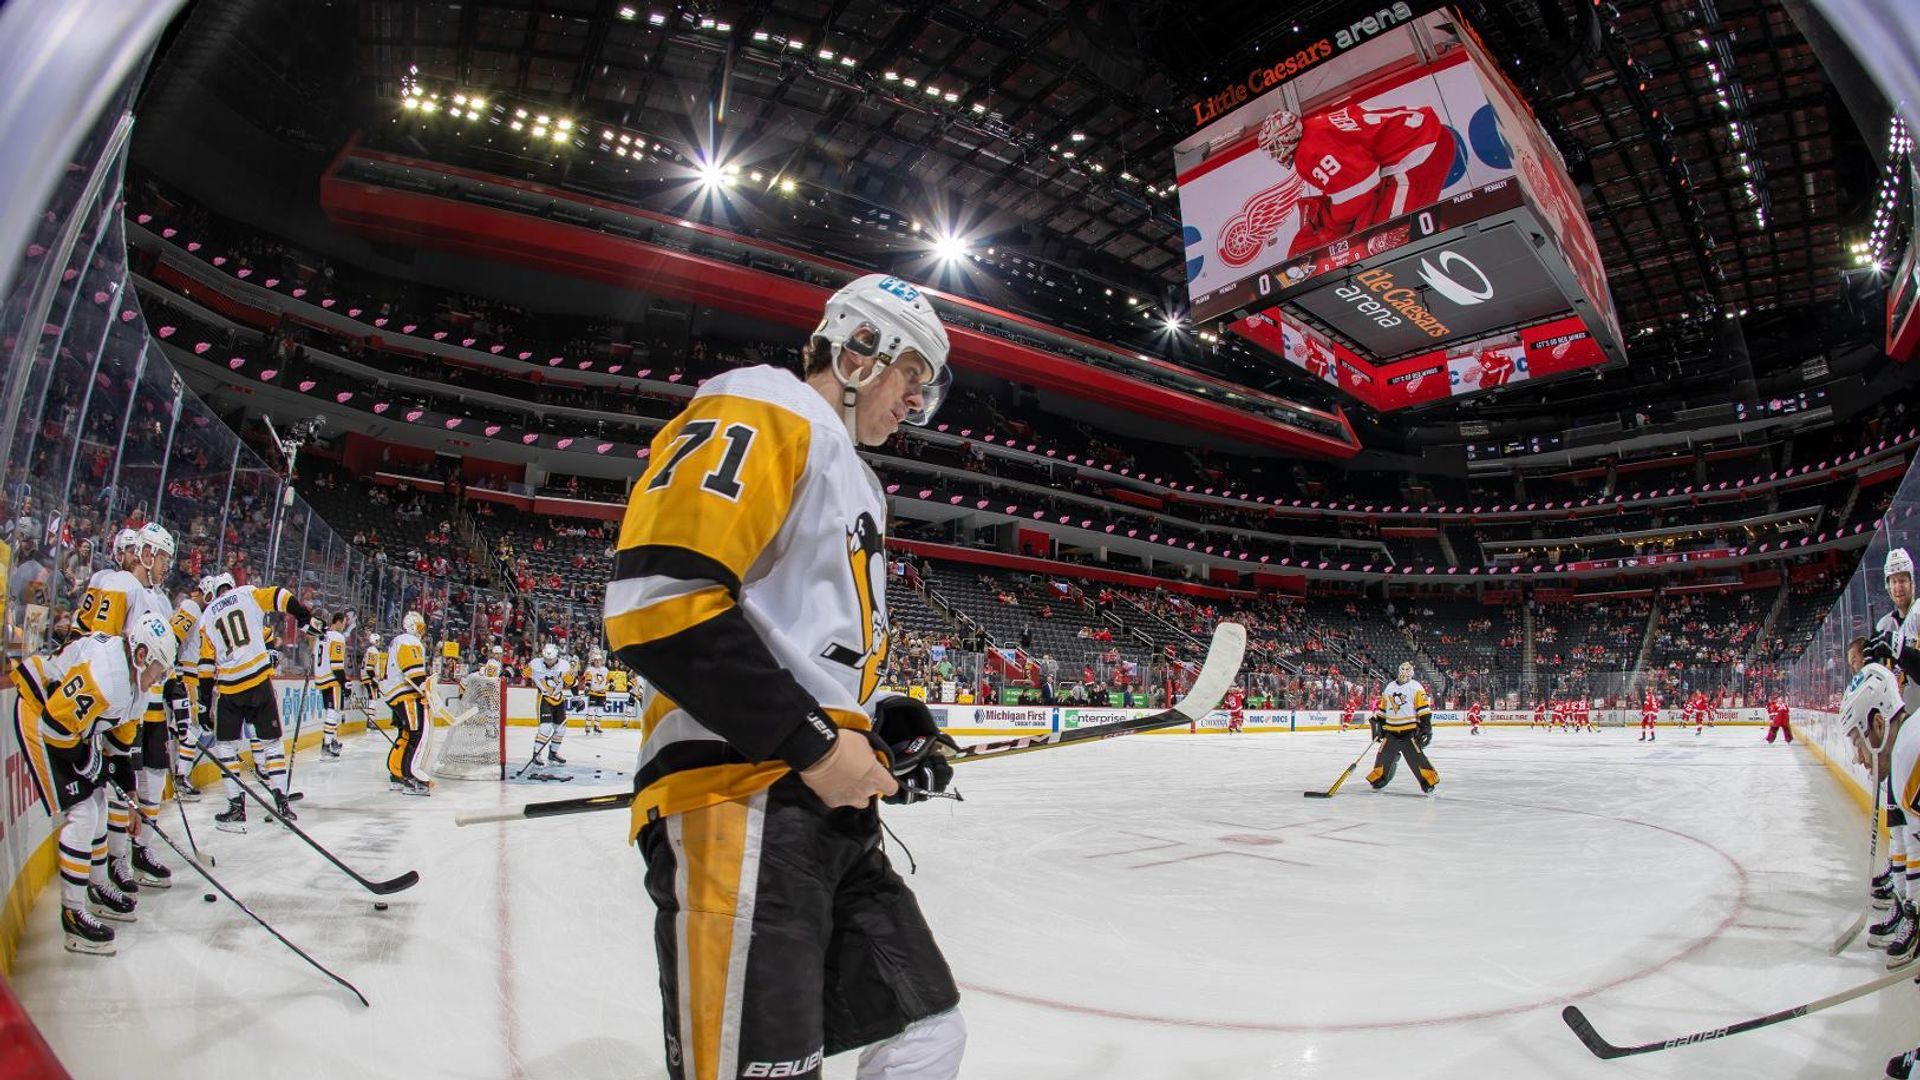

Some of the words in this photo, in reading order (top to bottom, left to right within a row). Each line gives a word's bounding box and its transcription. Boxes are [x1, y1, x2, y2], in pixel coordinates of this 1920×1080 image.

[1192, 82, 1248, 126] Little
[1249, 38, 1332, 93] Caesars
[1335, 2, 1412, 49] arena
[1312, 154, 1341, 186] 39
[1419, 212, 1434, 235] 0
[1258, 273, 1271, 295] 0
[1335, 285, 1402, 328] arena
[1383, 288, 1451, 337] Caesars
[644, 419, 758, 503] 71
[174, 614, 193, 632] 73
[214, 609, 251, 656] 10
[63, 675, 96, 721] 64
[986, 709, 1026, 722] Michigan
[1027, 709, 1046, 721] First
[1664, 1027, 1729, 1048] BAUER
